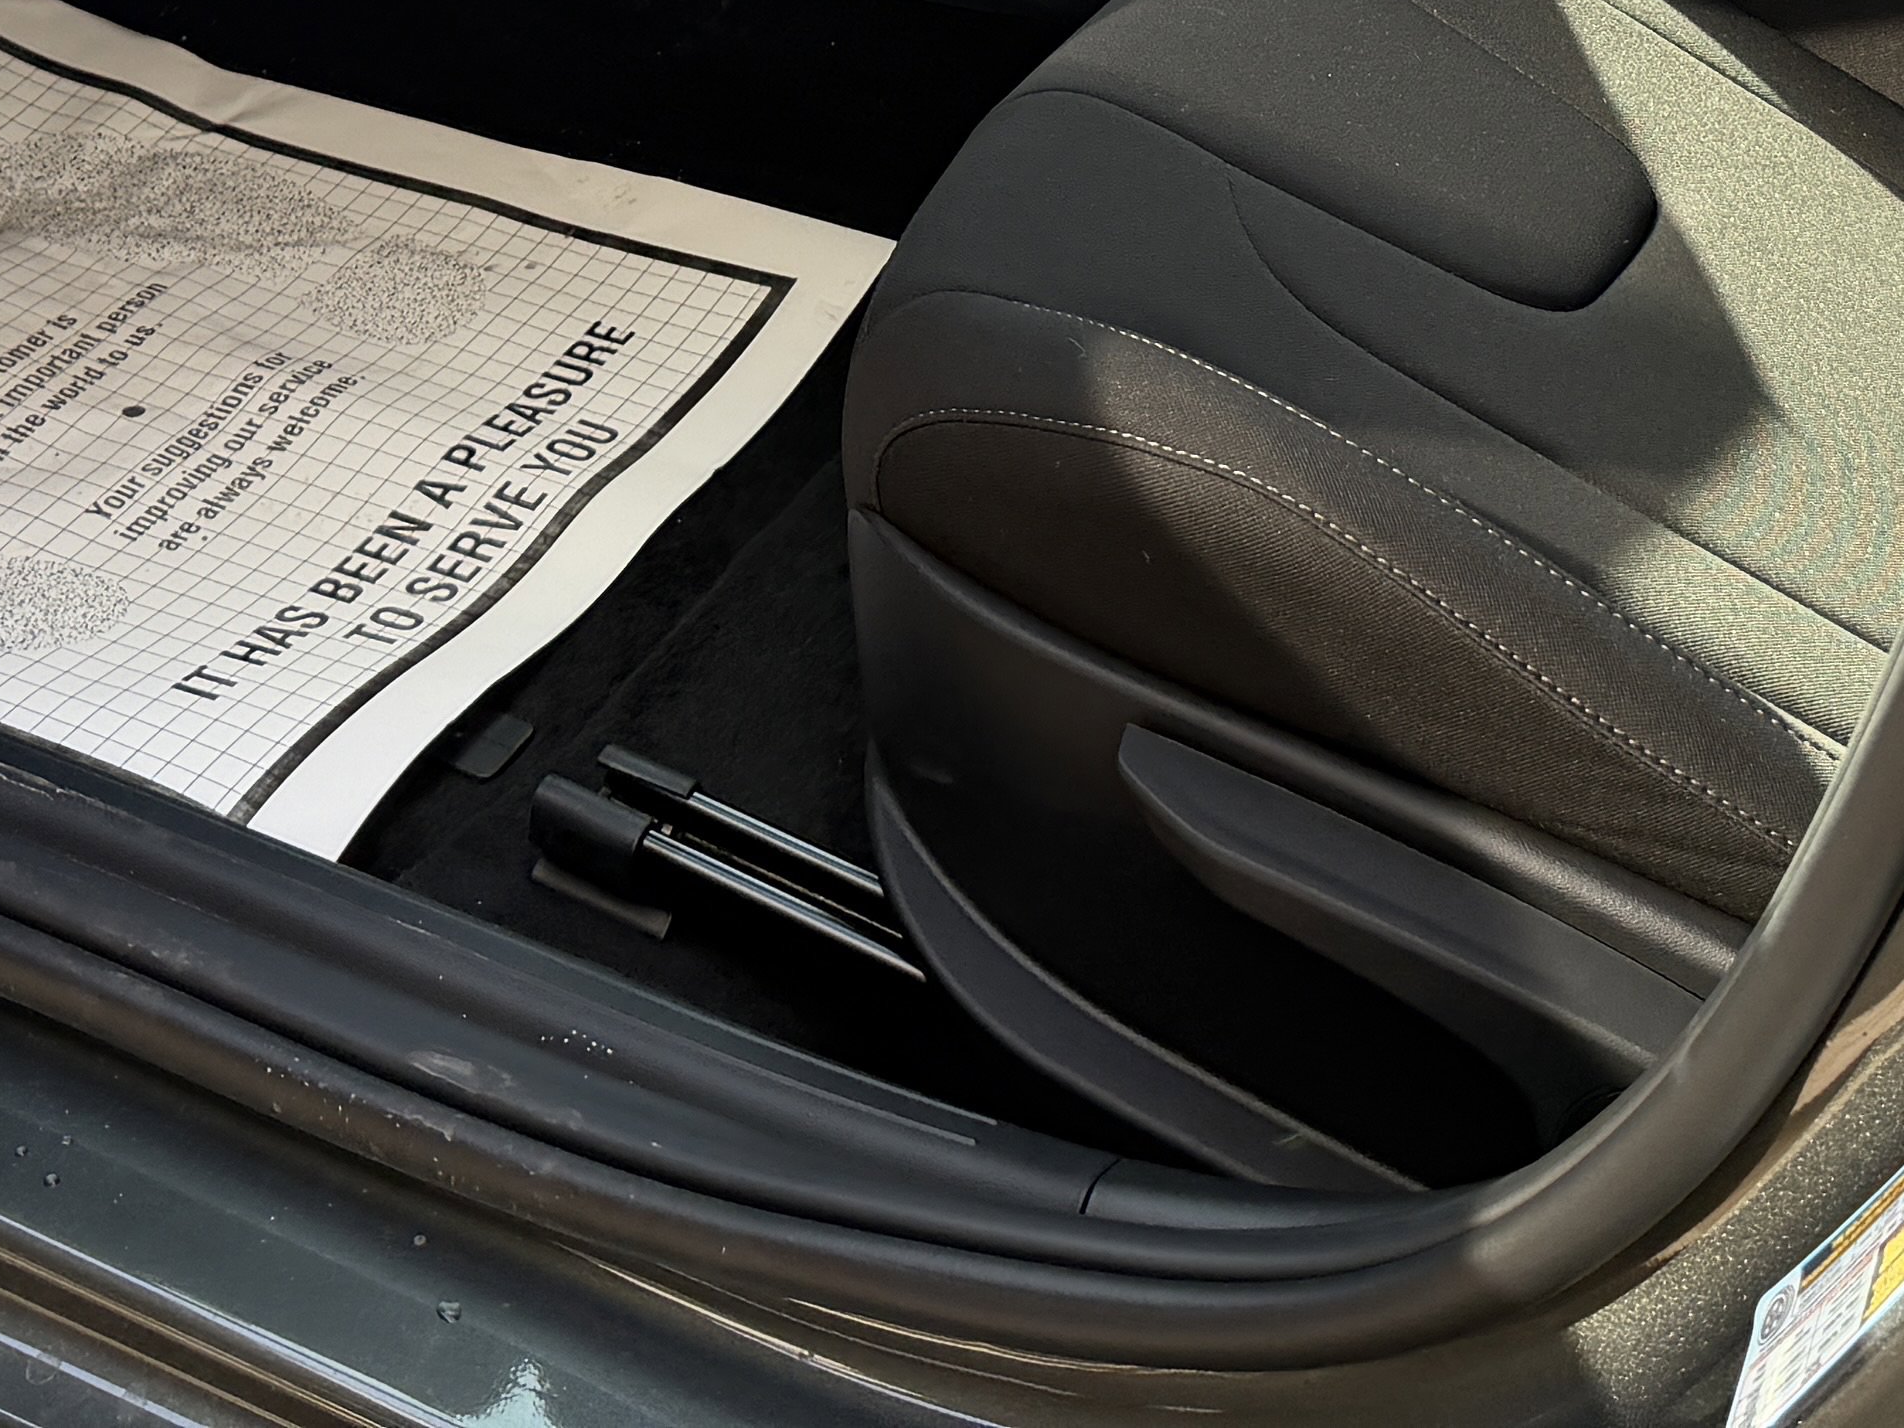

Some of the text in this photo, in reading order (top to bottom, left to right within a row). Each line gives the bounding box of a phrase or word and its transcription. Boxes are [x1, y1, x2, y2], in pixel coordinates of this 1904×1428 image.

[0, 413, 47, 445] the
[41, 366, 106, 412] world
[97, 349, 129, 370] to
[124, 322, 164, 347] us.
[47, 312, 78, 332] is
[96, 282, 169, 335] person
[84, 350, 295, 521] Your suggestions for
[113, 357, 334, 542] improving our service
[157, 373, 367, 552] are always welcome.
[171, 319, 637, 701] IT HAS BEEN A PLEASURE
[342, 418, 621, 646] TO SERVE YOU
